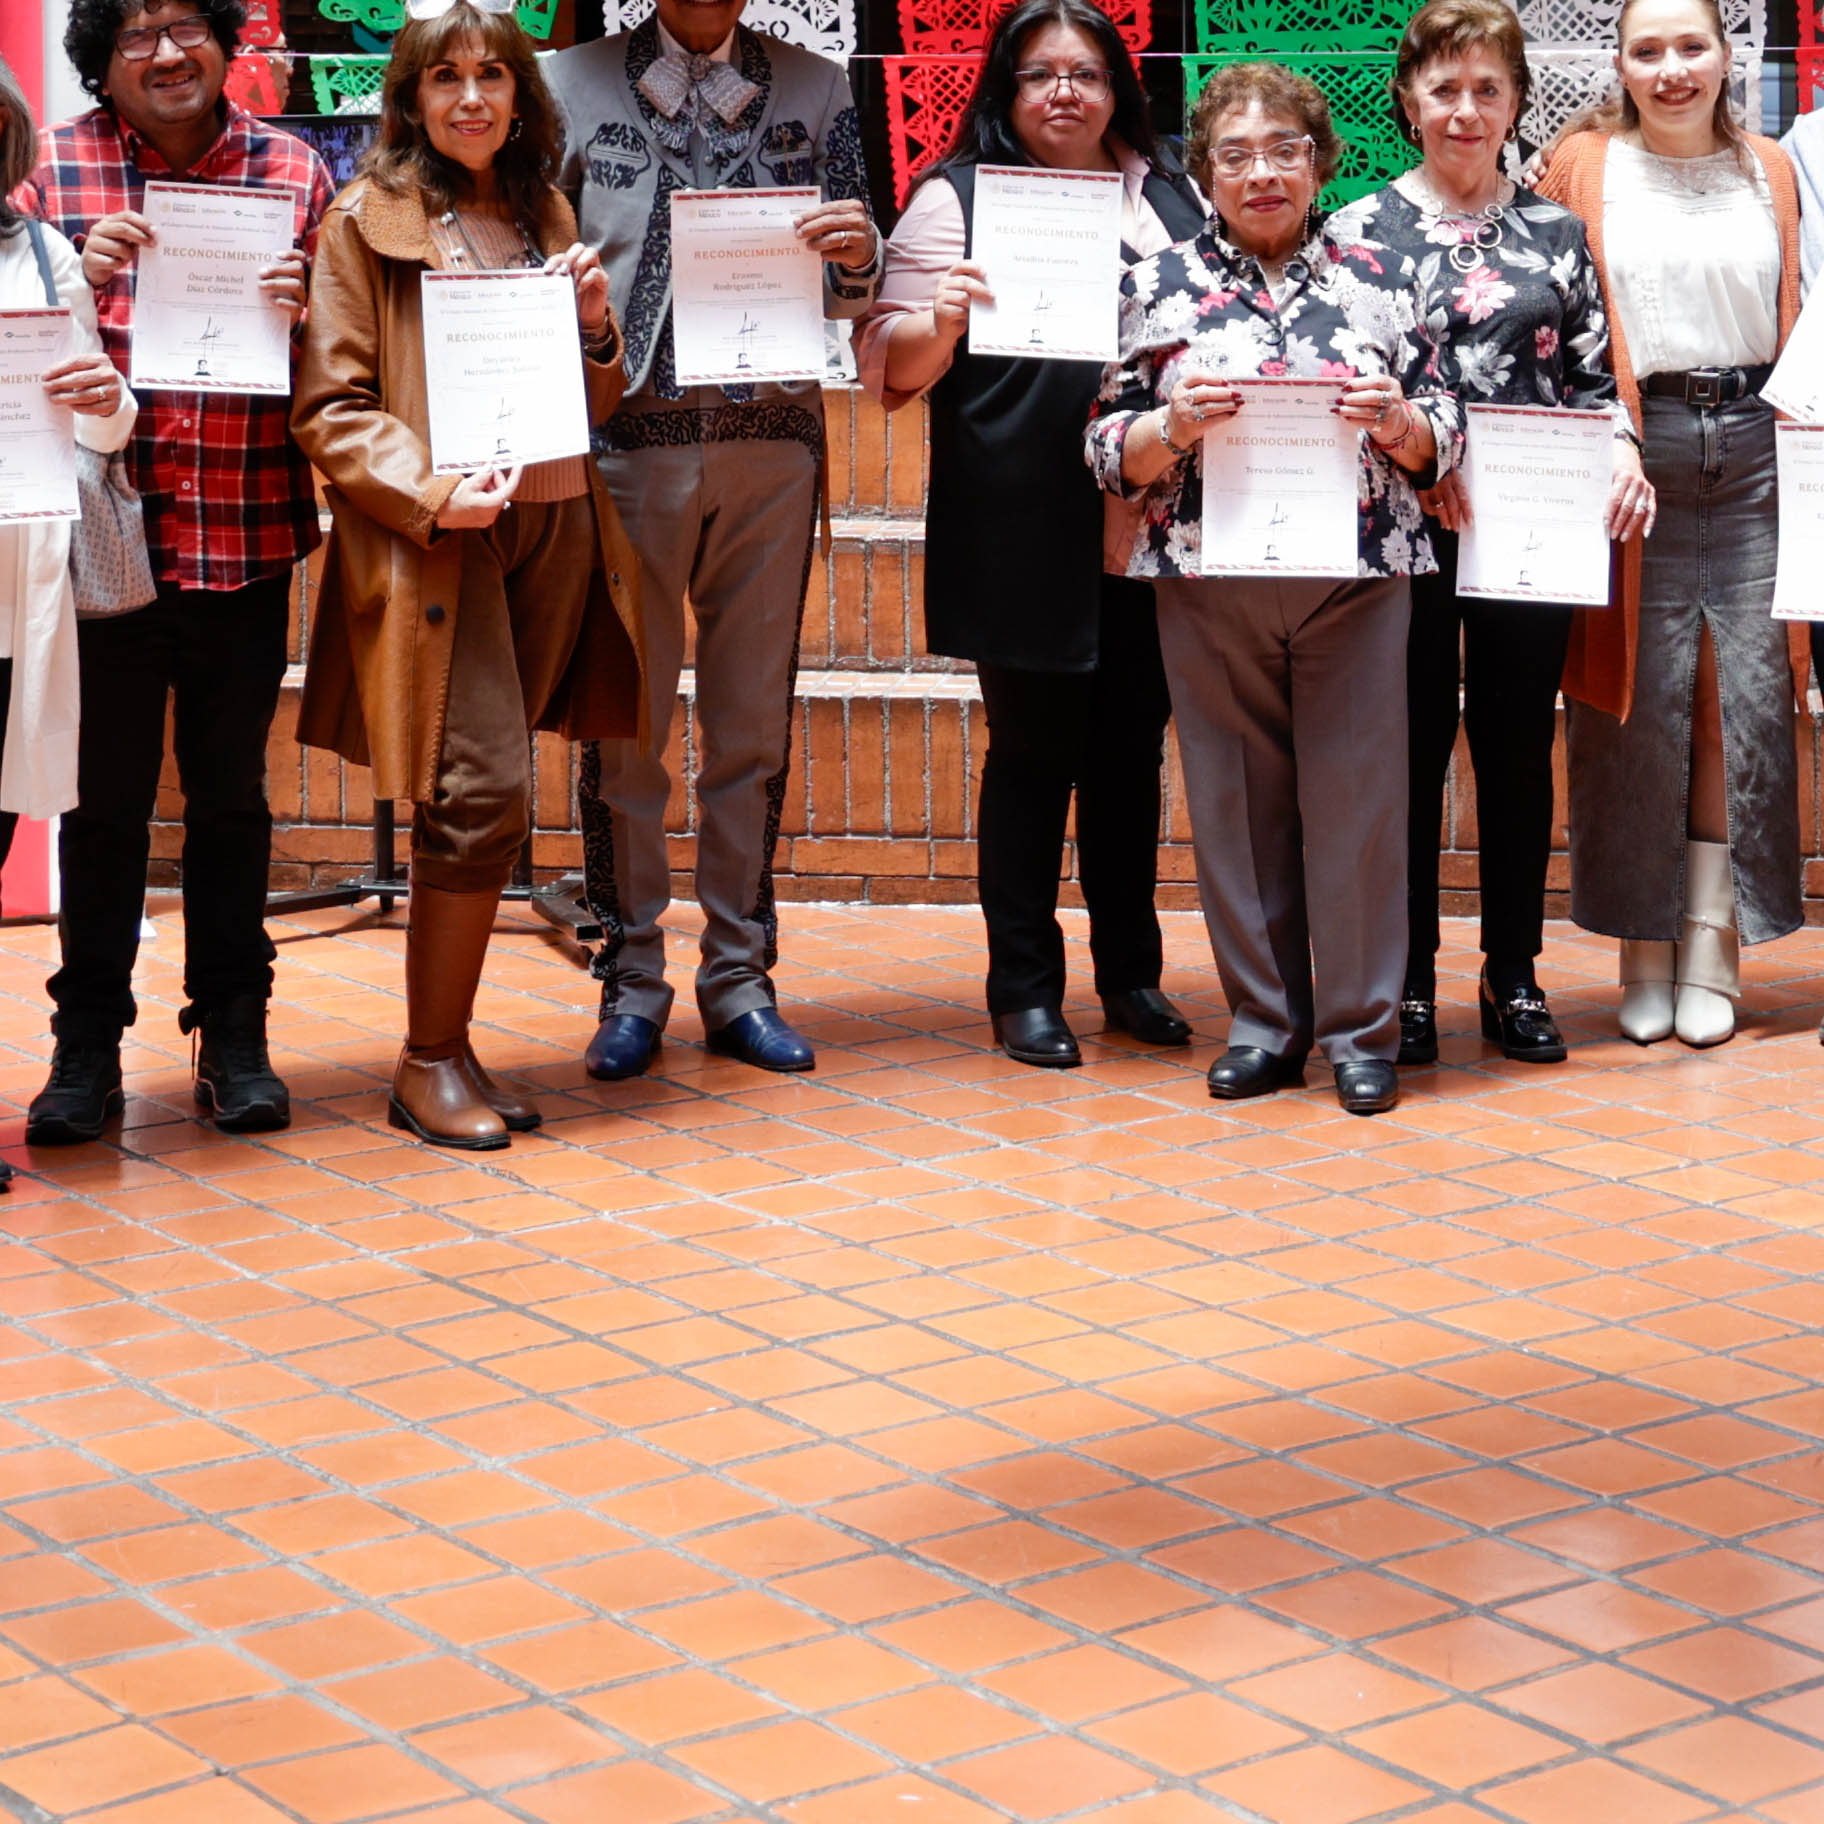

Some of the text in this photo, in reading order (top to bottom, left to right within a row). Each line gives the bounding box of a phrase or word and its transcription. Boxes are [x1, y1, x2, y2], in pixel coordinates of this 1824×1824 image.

[163, 246, 272, 263] RECONOCIMIENTO
[694, 247, 800, 260] RECONOCIMIENTO
[215, 274, 244, 285] Michel
[446, 327, 555, 344] RECONOCIMIENTO
[1226, 436, 1336, 448] RECONOCIMIENTO
[1244, 465, 1273, 475] Teresa
[1484, 463, 1592, 480] RECONOCIMIENTO
